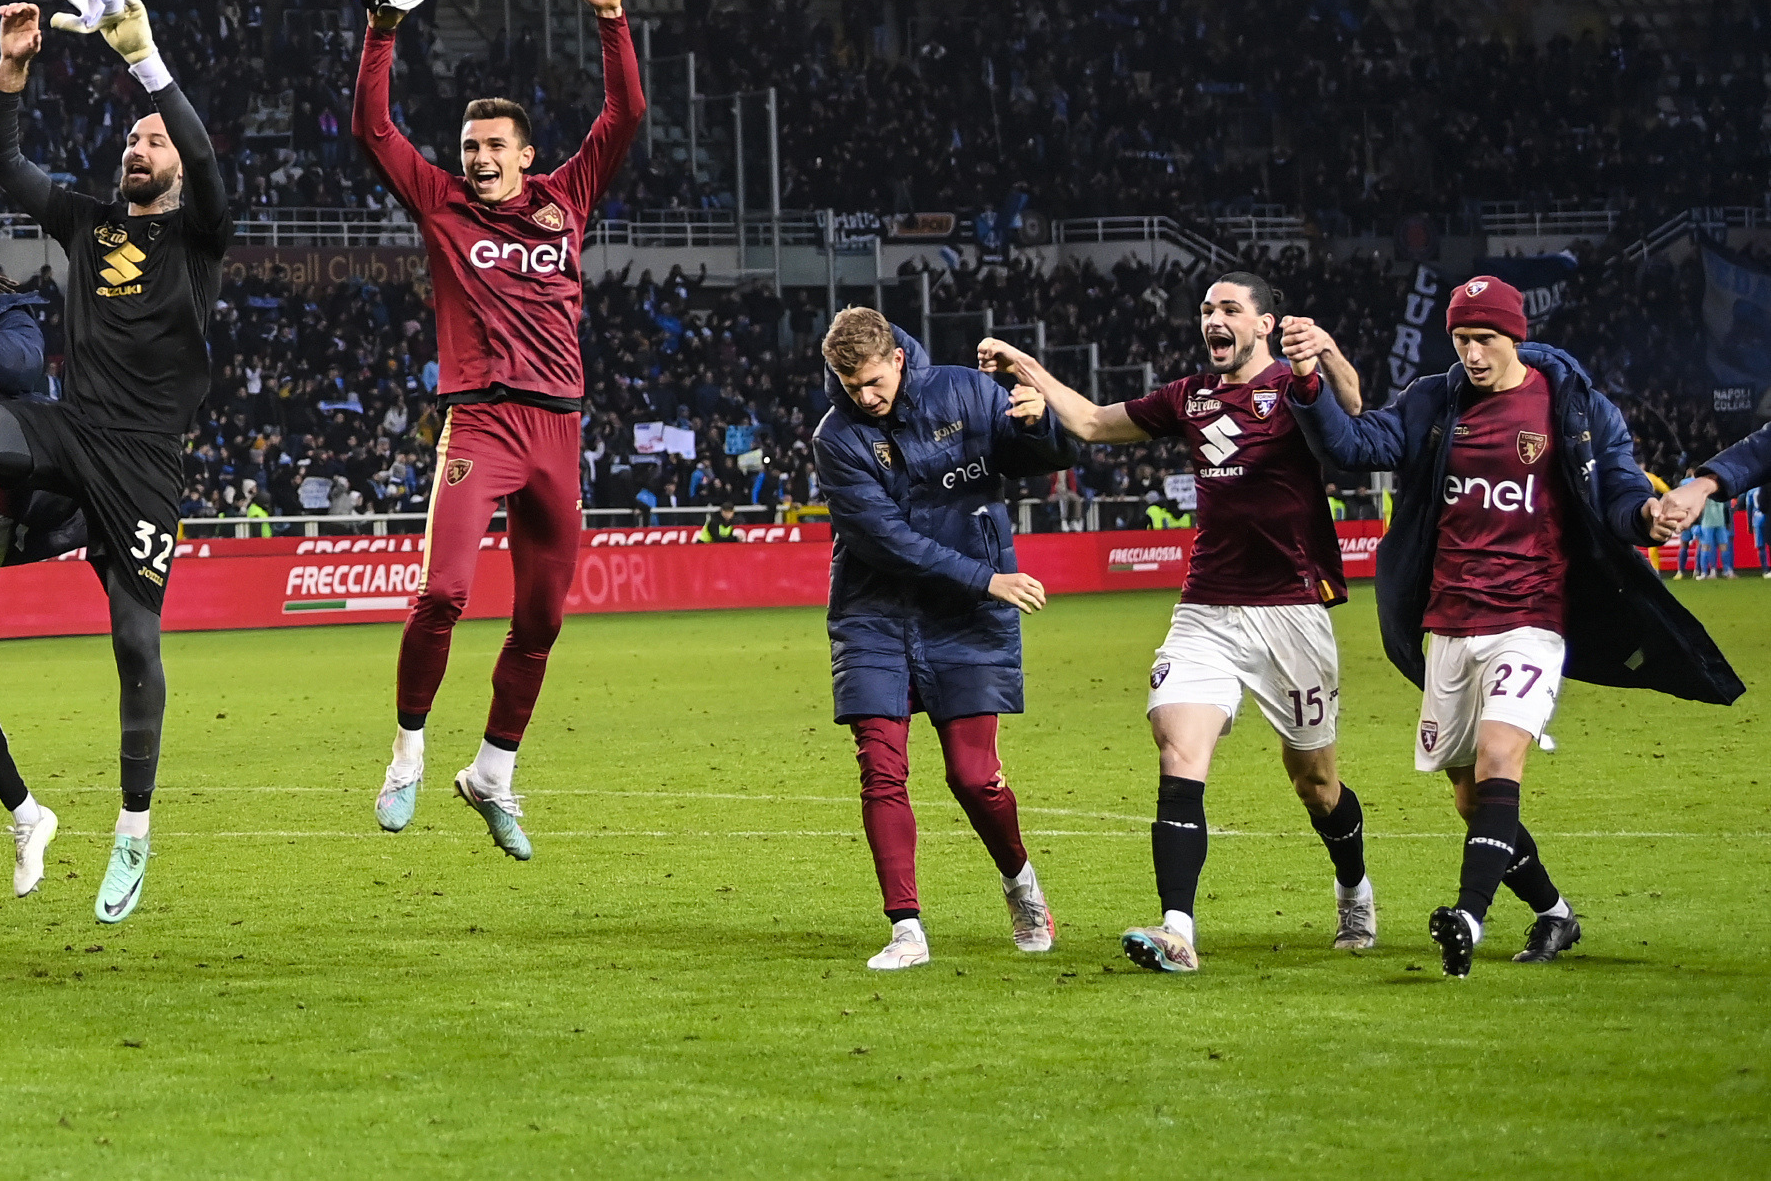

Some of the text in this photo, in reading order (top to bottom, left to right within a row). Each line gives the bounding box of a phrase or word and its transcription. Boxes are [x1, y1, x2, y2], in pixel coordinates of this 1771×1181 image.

[329, 252, 388, 284] Club
[470, 236, 568, 273] enel
[1713, 388, 1751, 400] NAPOLI
[1714, 399, 1753, 412] COLERA
[942, 456, 988, 489] enel
[1199, 467, 1244, 478] SUZUKI
[1443, 473, 1535, 514] enel
[130, 519, 174, 573] 32
[1109, 546, 1183, 563] FRECCIAROSSA
[1489, 663, 1543, 699] 27
[1288, 685, 1324, 727] 15
